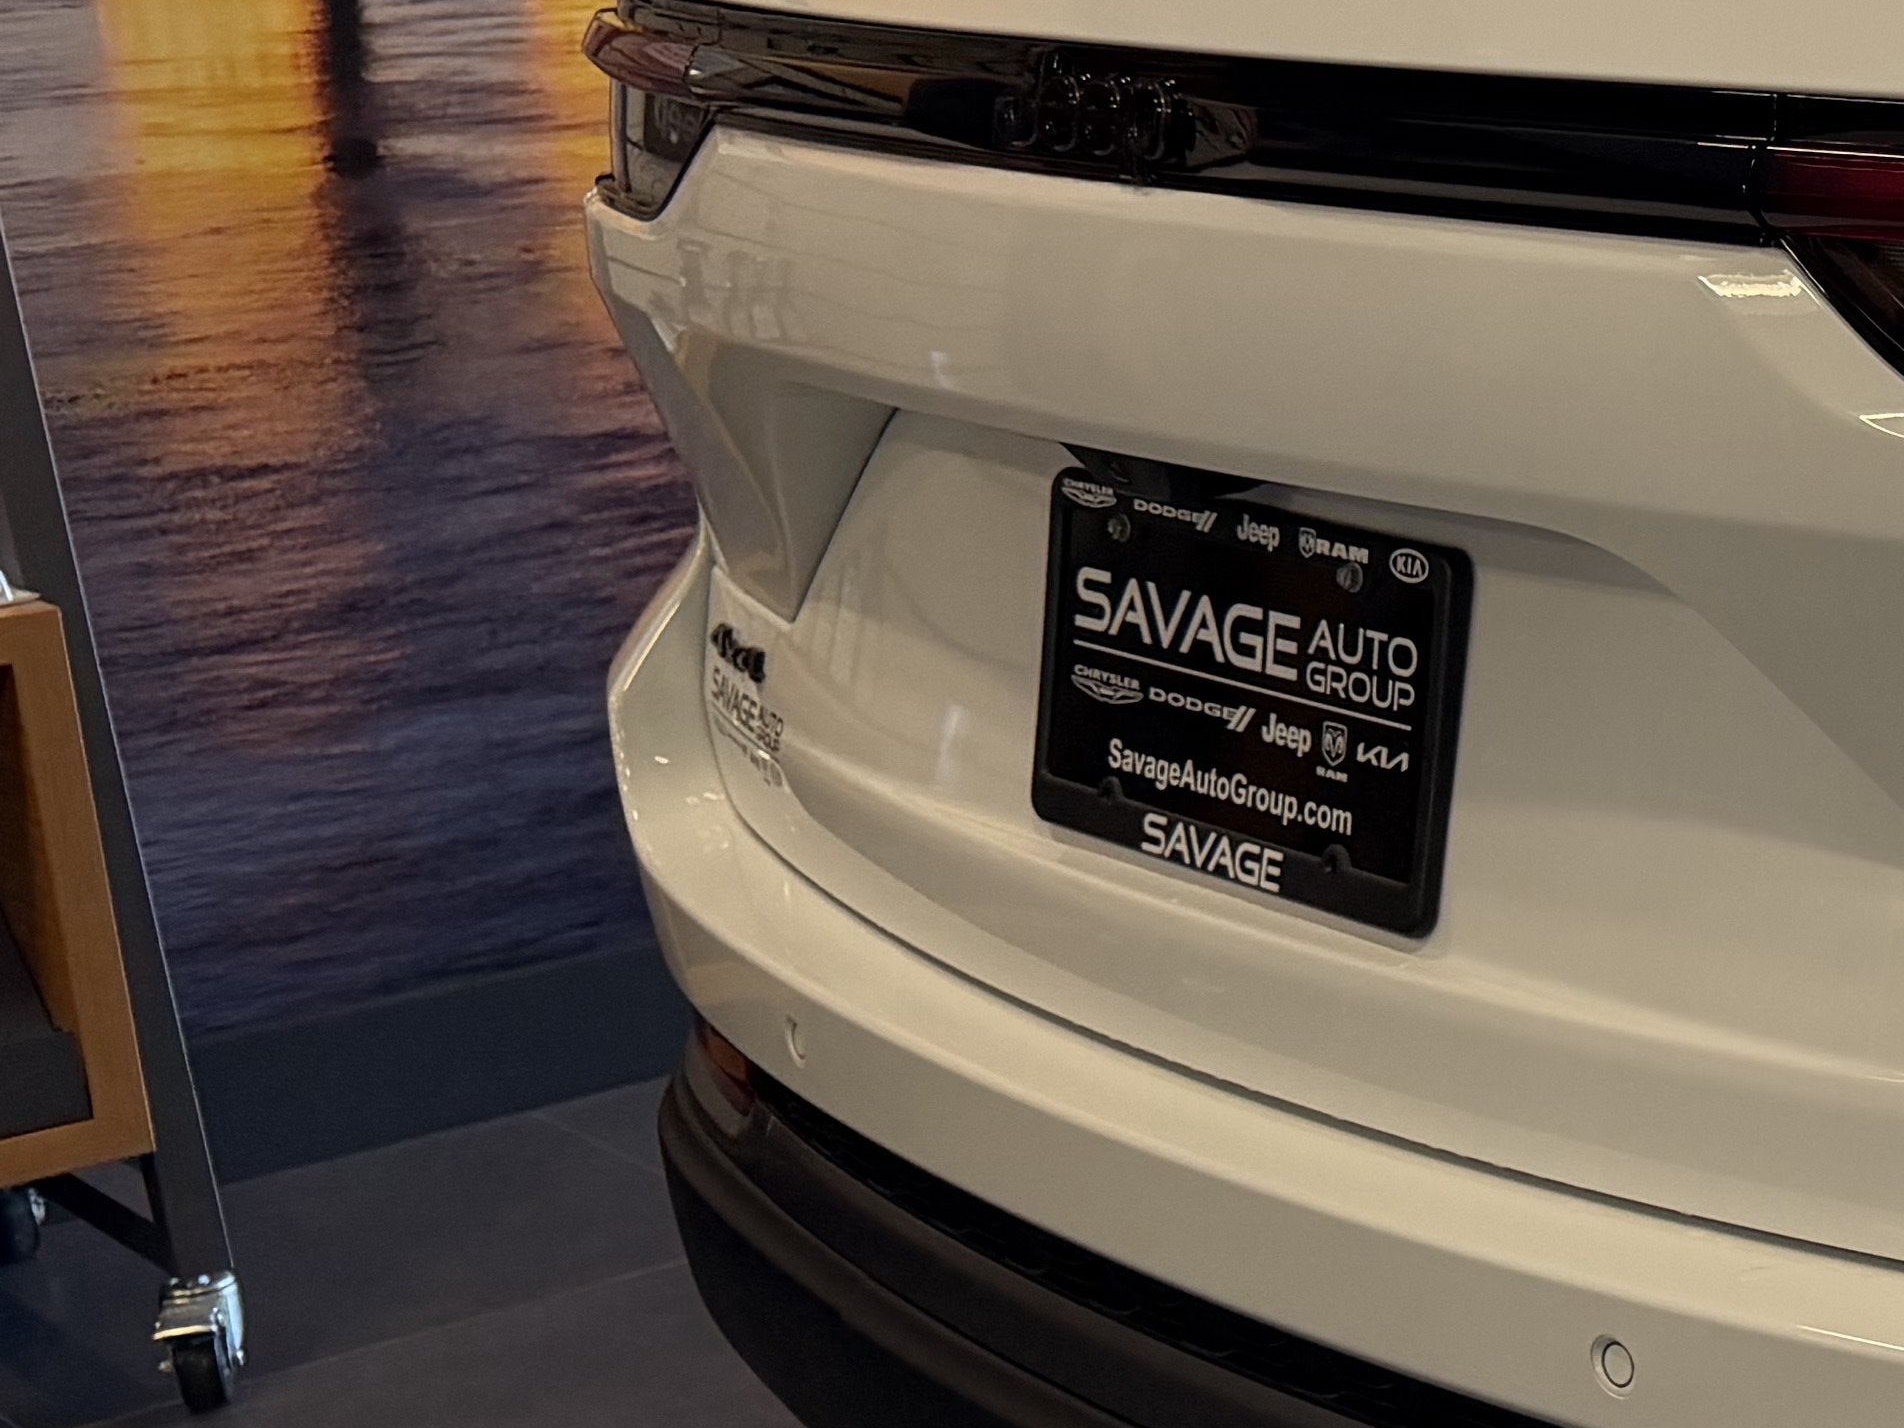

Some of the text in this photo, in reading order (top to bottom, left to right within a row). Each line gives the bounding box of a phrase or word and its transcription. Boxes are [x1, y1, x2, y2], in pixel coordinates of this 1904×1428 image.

[1063, 477, 1422, 576] CHRYSLER DODGE Jeep RAM KIA
[1074, 566, 1418, 681] SAVAGE AUTO
[1074, 664, 1141, 690] CHRYSLER
[1149, 687, 1241, 723] DODGE
[1262, 713, 1312, 757] Jeep
[1306, 661, 1415, 711] GROUP
[1108, 738, 1352, 835] SavageAutoGroup.com
[1316, 766, 1348, 783] RAM
[1141, 812, 1285, 893] SAVAGE
